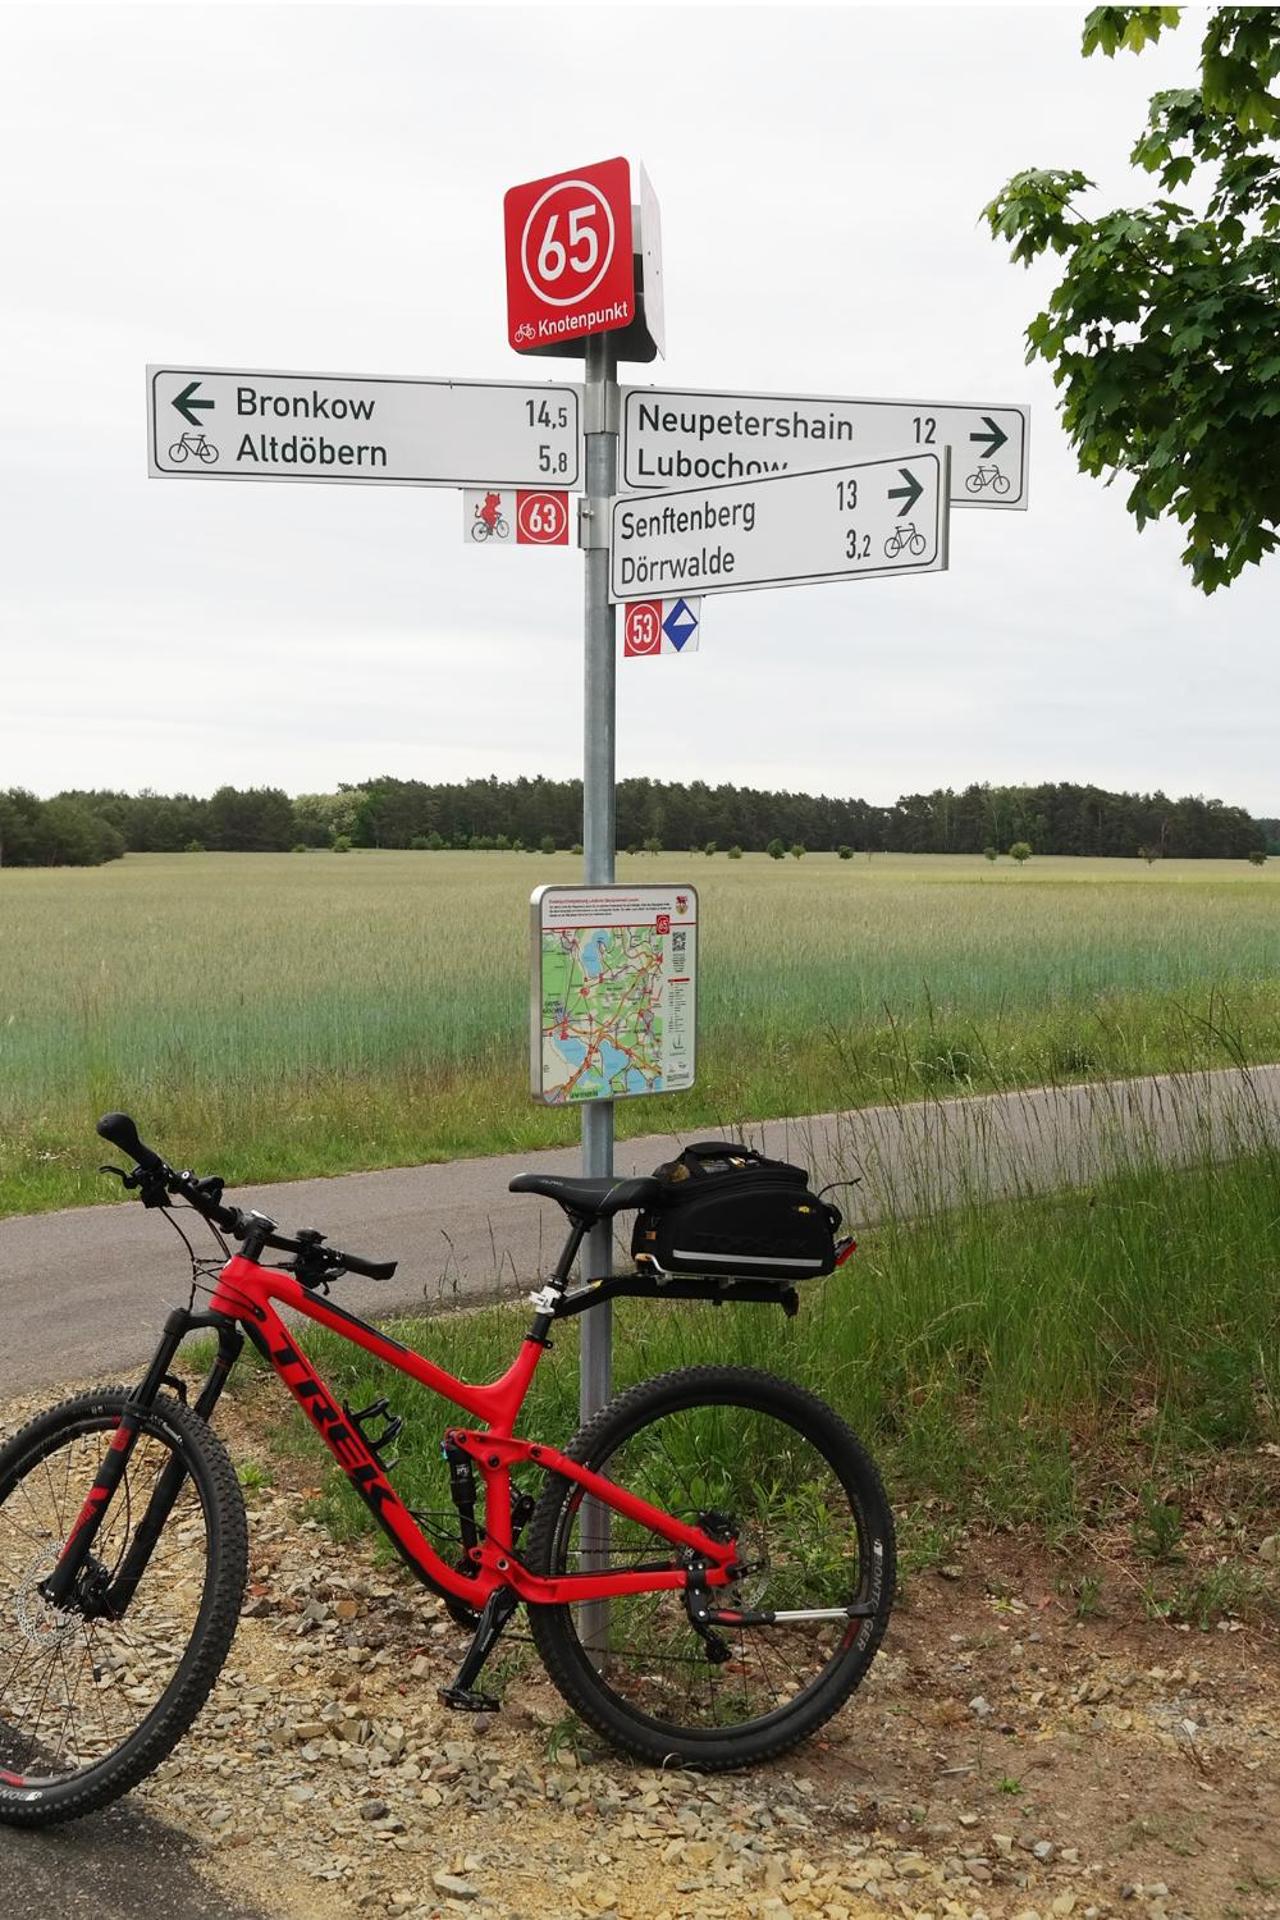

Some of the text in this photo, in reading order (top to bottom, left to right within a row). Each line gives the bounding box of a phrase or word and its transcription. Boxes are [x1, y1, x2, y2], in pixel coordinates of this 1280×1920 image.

[539, 204, 599, 281] 65
[538, 301, 628, 337] Knotenpunkt
[237, 387, 568, 429] Bronkow 14,5
[638, 404, 937, 444] Neupetershain 12
[236, 434, 568, 473] Altdöbern 5,8
[529, 503, 556, 531] 63
[621, 480, 858, 540] Senftenberg 13
[621, 529, 871, 584] Dörrwalde 3,2
[632, 612, 653, 644] 53
[274, 1331, 398, 1511] TREK
